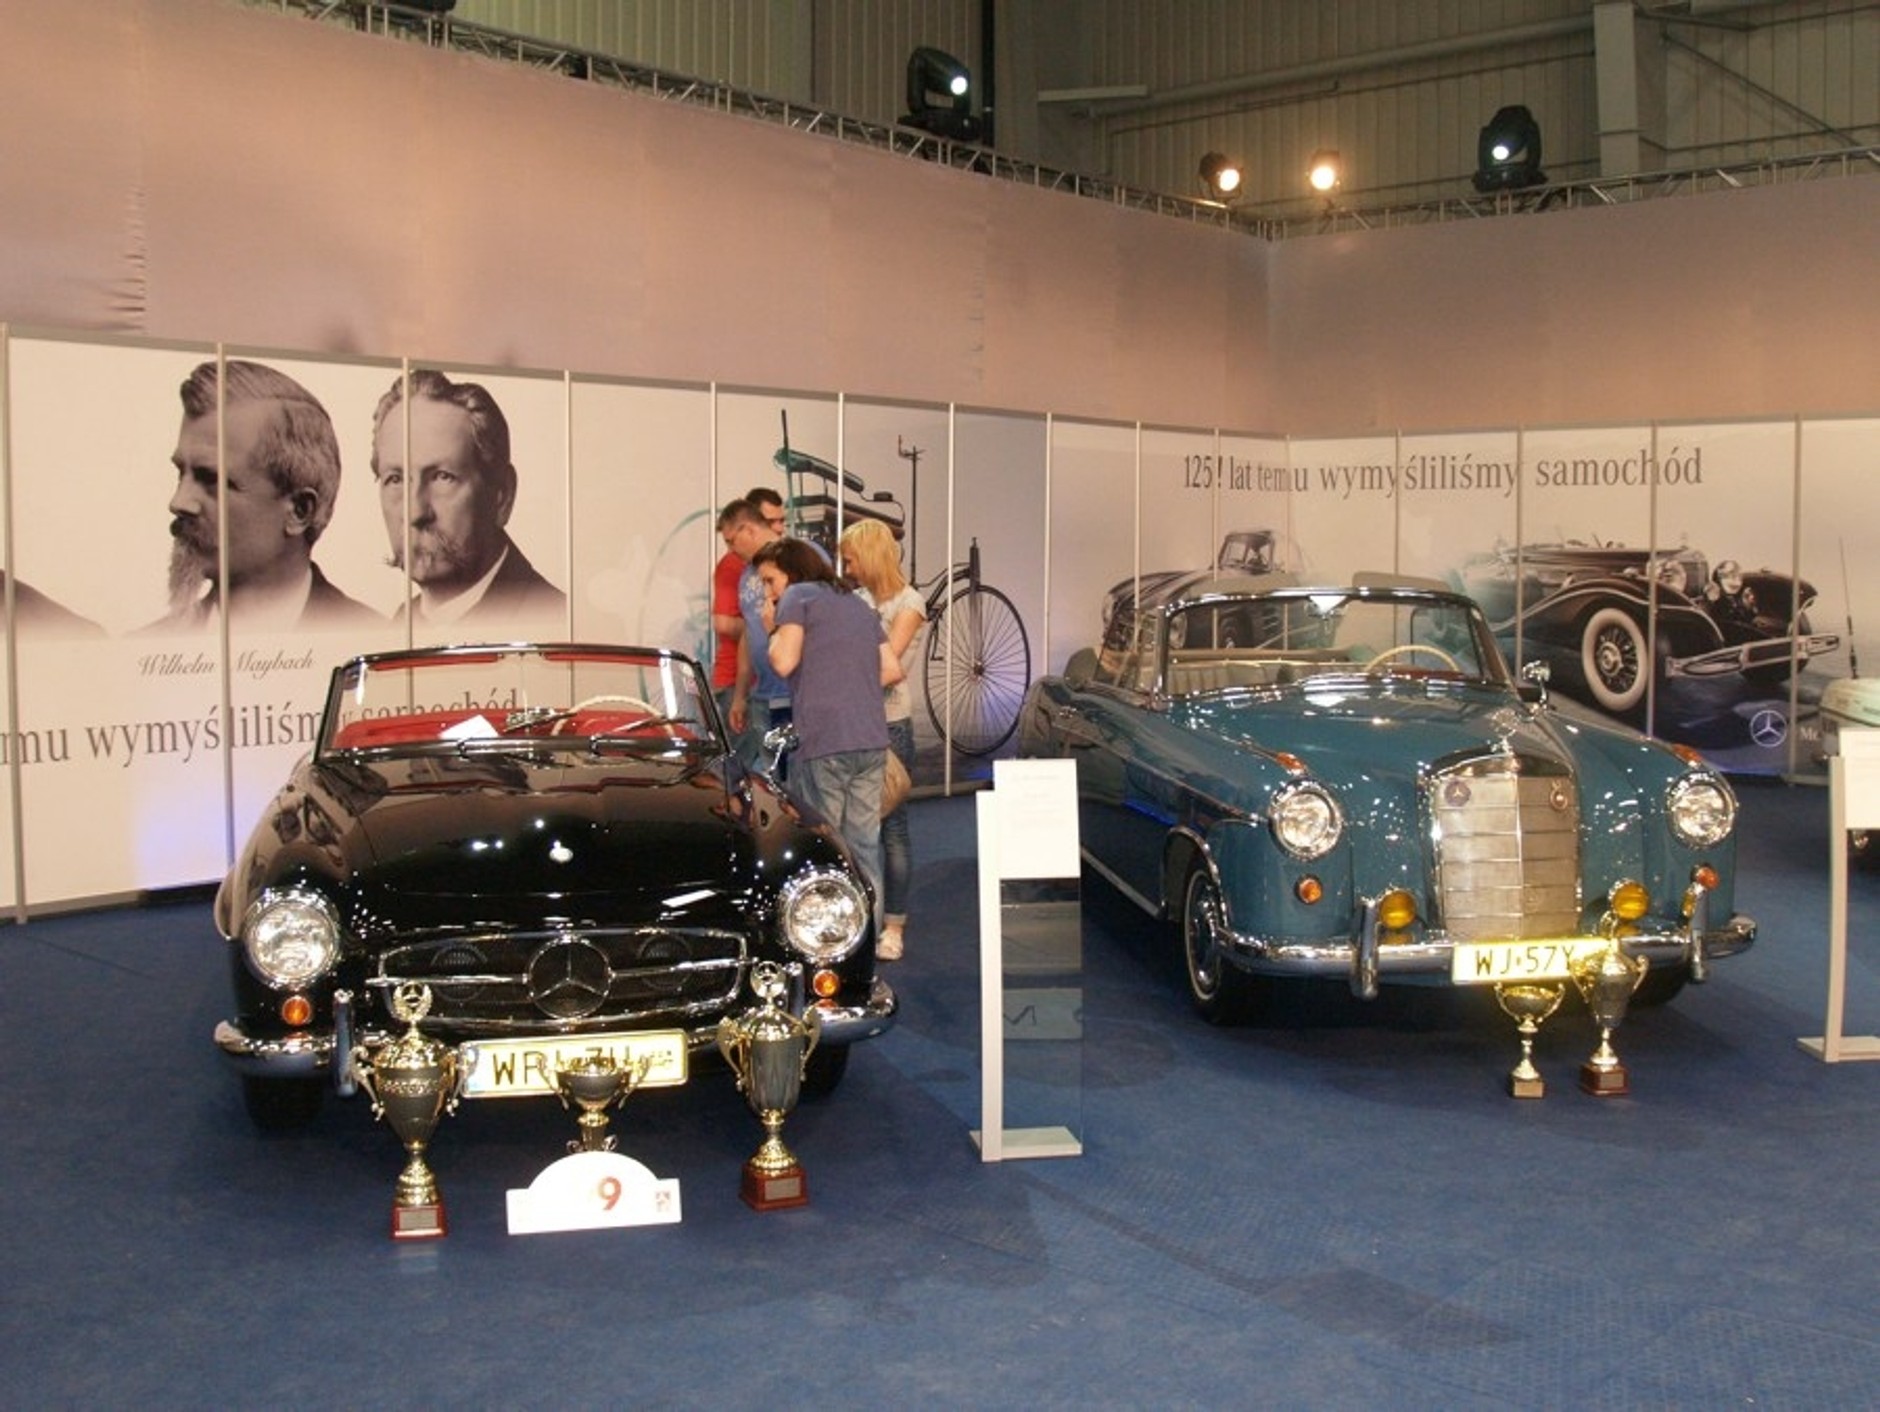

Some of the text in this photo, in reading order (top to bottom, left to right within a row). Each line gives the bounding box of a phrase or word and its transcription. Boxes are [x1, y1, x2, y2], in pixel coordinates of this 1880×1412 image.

[1229, 455, 1253, 491] lat
[1257, 462, 1309, 493] temu
[1319, 453, 1517, 500] wymyśliliśmy
[1535, 446, 1704, 487] samochód
[138, 649, 314, 679] Wilhelm Maybach
[598, 1176, 622, 1211] 9
